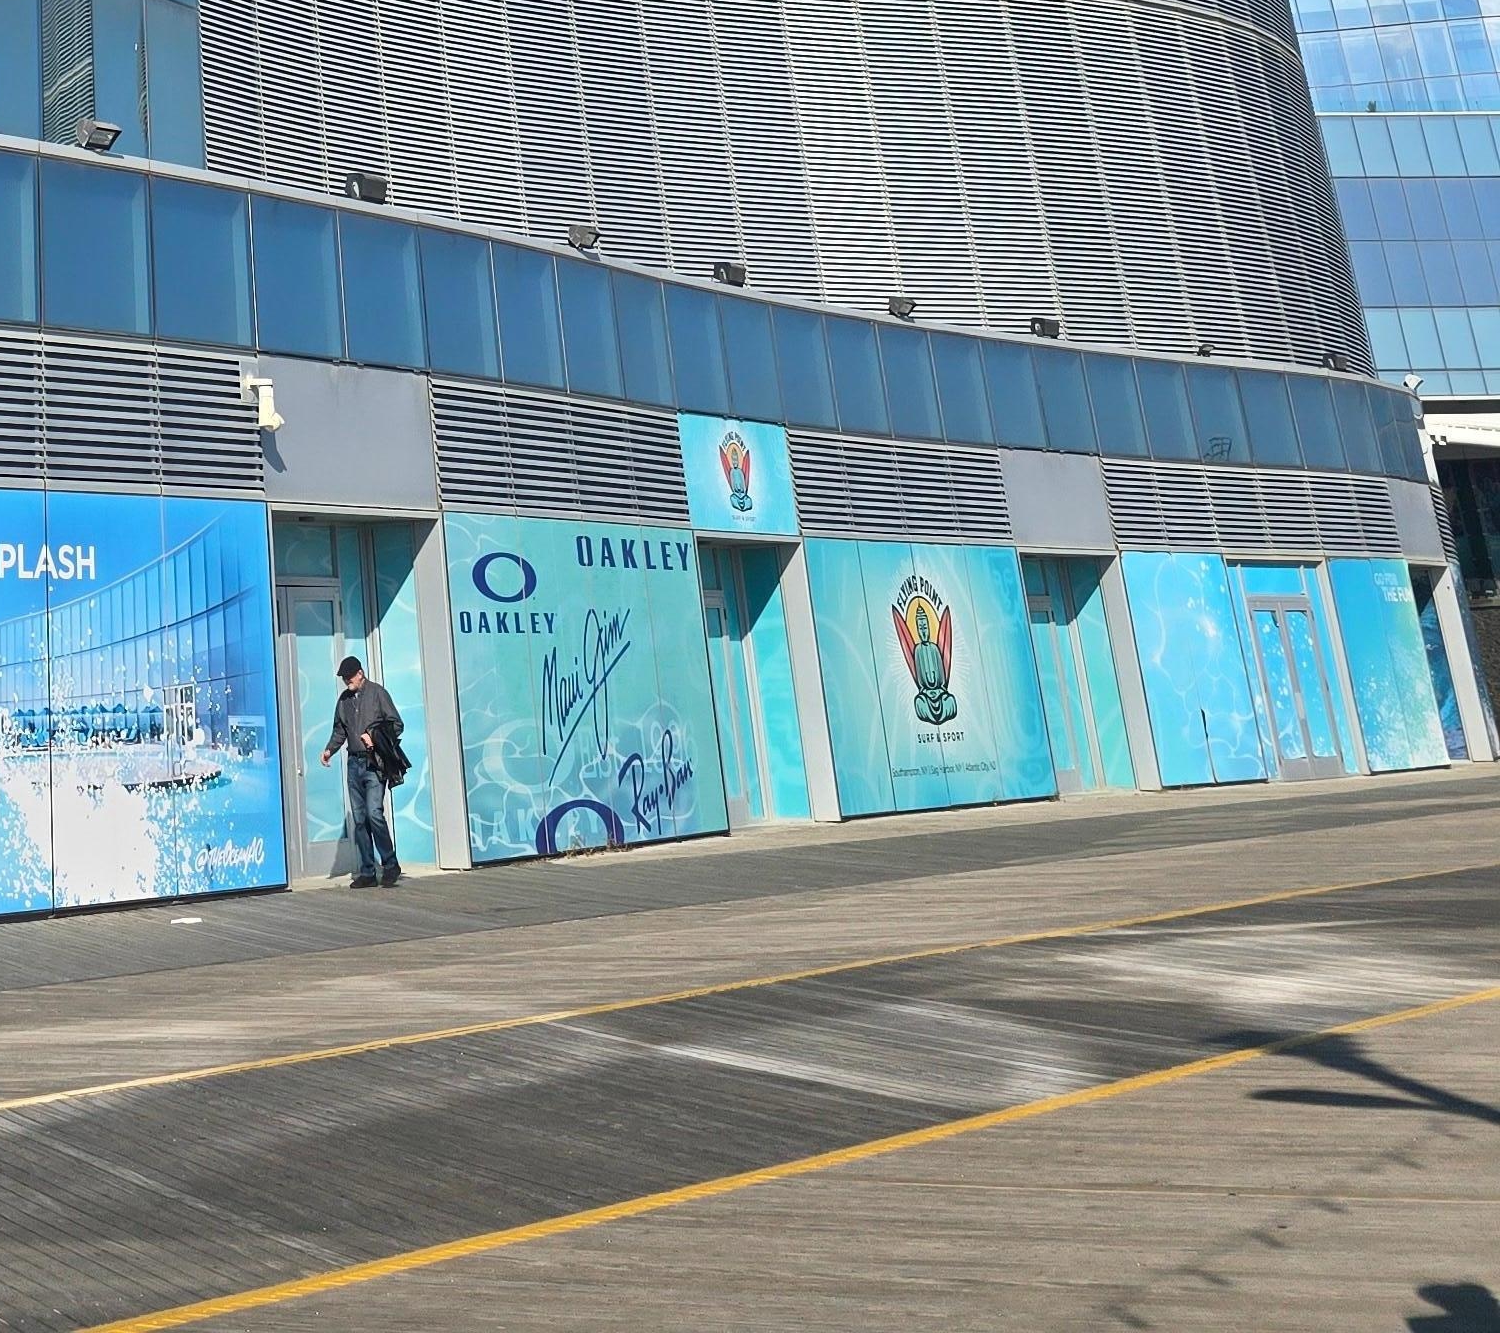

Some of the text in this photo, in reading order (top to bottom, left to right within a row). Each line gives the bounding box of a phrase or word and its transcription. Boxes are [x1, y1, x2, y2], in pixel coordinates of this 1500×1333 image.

[575, 535, 690, 571] OAKLEY
[897, 575, 943, 613] FLYING POINT
[459, 611, 555, 634] OAKLEY
[542, 646, 583, 756] Maui
[583, 608, 631, 760] Jim
[917, 733, 934, 743] SURF
[943, 731, 965, 742] SPORT
